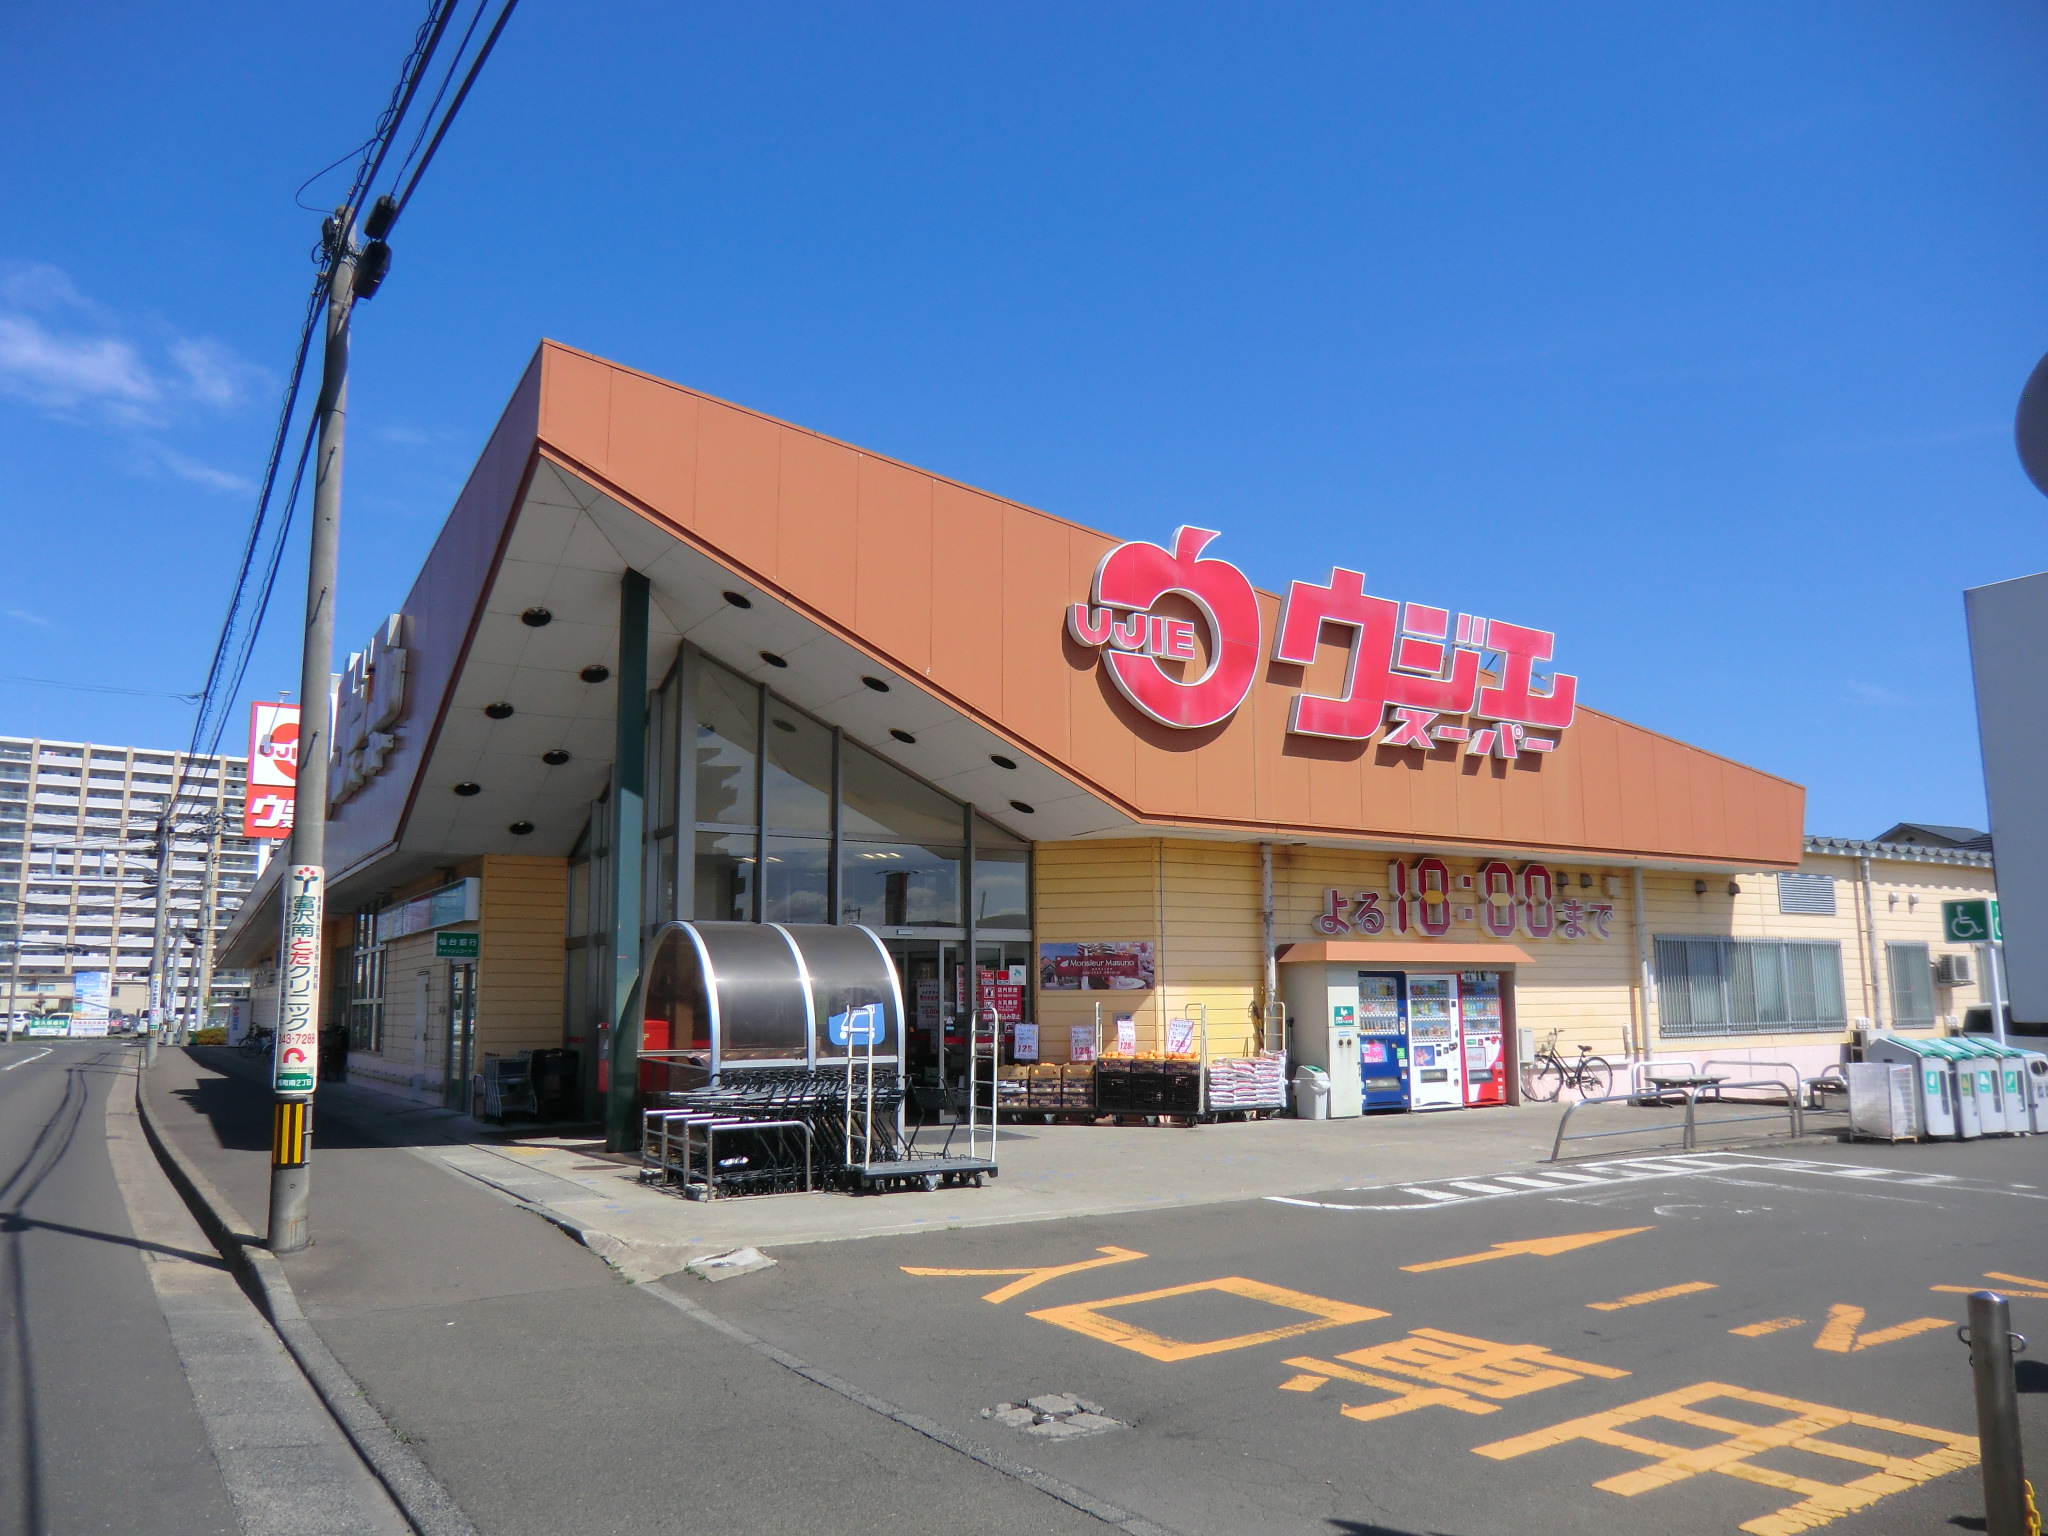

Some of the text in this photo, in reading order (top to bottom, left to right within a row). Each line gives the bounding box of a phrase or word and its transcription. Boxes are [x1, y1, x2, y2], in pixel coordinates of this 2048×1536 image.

[1068, 603, 1196, 661] UJIE
[1273, 566, 1578, 741] ウジエ
[1378, 707, 1556, 760] スーパー
[259, 744, 297, 760] UJI
[438, 938, 478, 947] 仙台銀行
[286, 895, 317, 1032] 富沢南とだクリニック
[1069, 959, 1135, 967] Monsieur Masuno
[278, 1033, 316, 1045] 243-7288
[1017, 1044, 1033, 1053] 128
[1074, 1046, 1091, 1055] 128
[1119, 1041, 1132, 1050] 128
